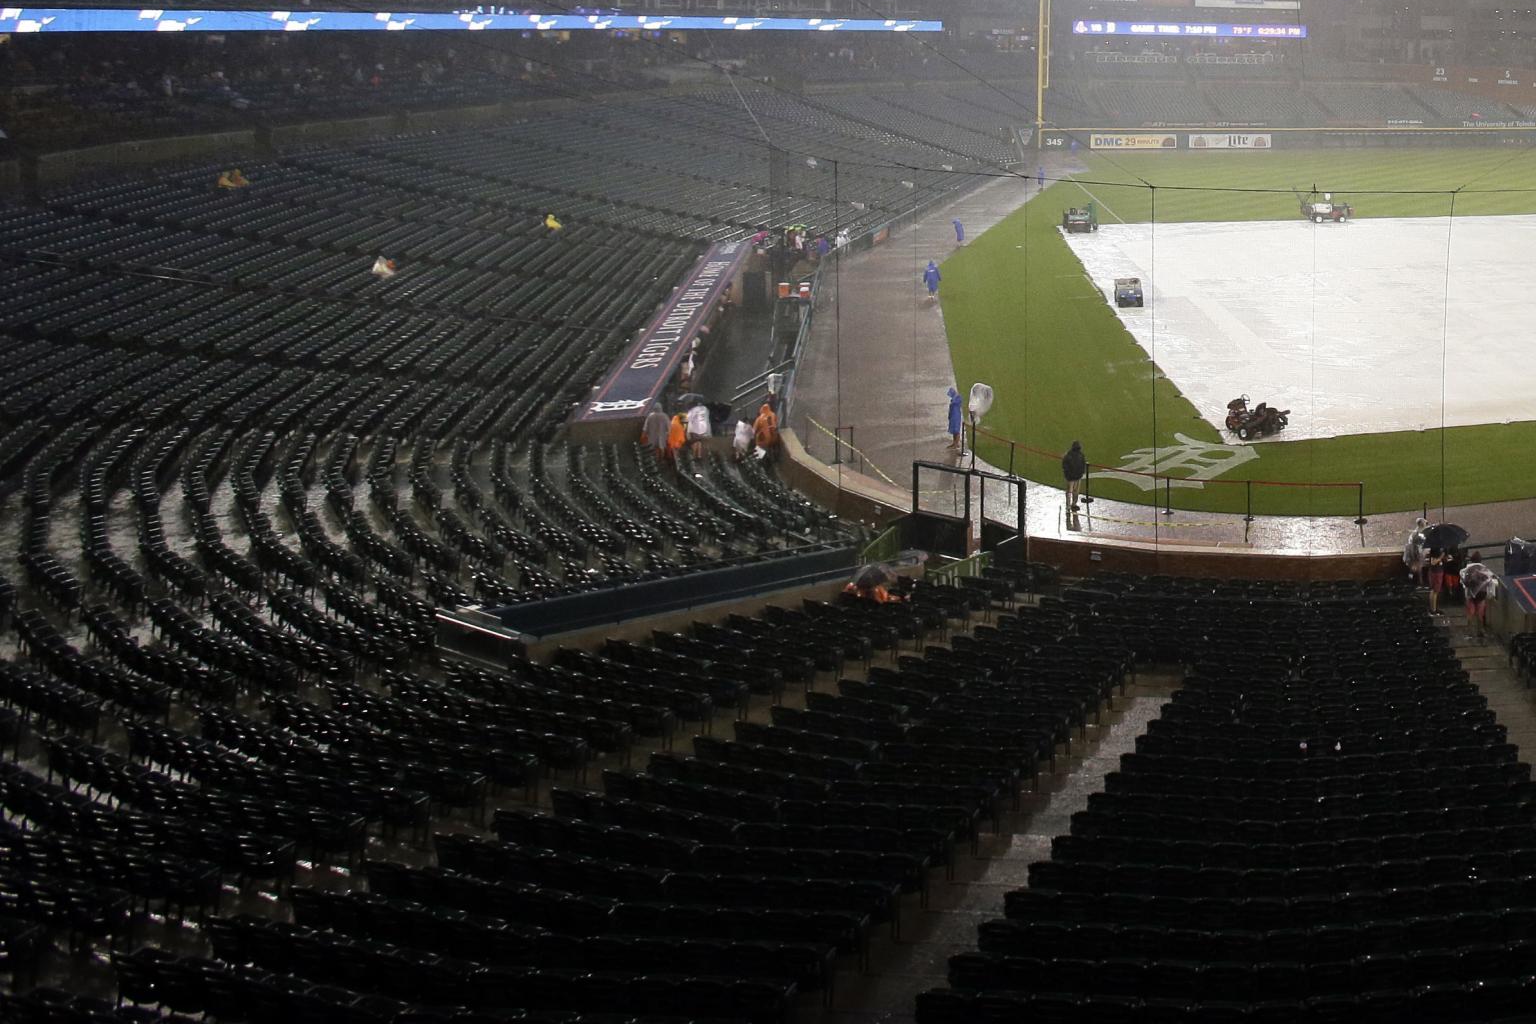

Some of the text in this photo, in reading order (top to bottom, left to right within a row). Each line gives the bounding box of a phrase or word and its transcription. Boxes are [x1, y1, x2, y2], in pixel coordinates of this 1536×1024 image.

[1203, 26, 1217, 34] PM
[1288, 28, 1301, 36] PM
[1475, 120, 1506, 128] University
[1094, 137, 1123, 147] DMC
[1124, 137, 1137, 146] 29
[655, 301, 704, 335] DETROIT
[629, 335, 681, 370] TIGERS
